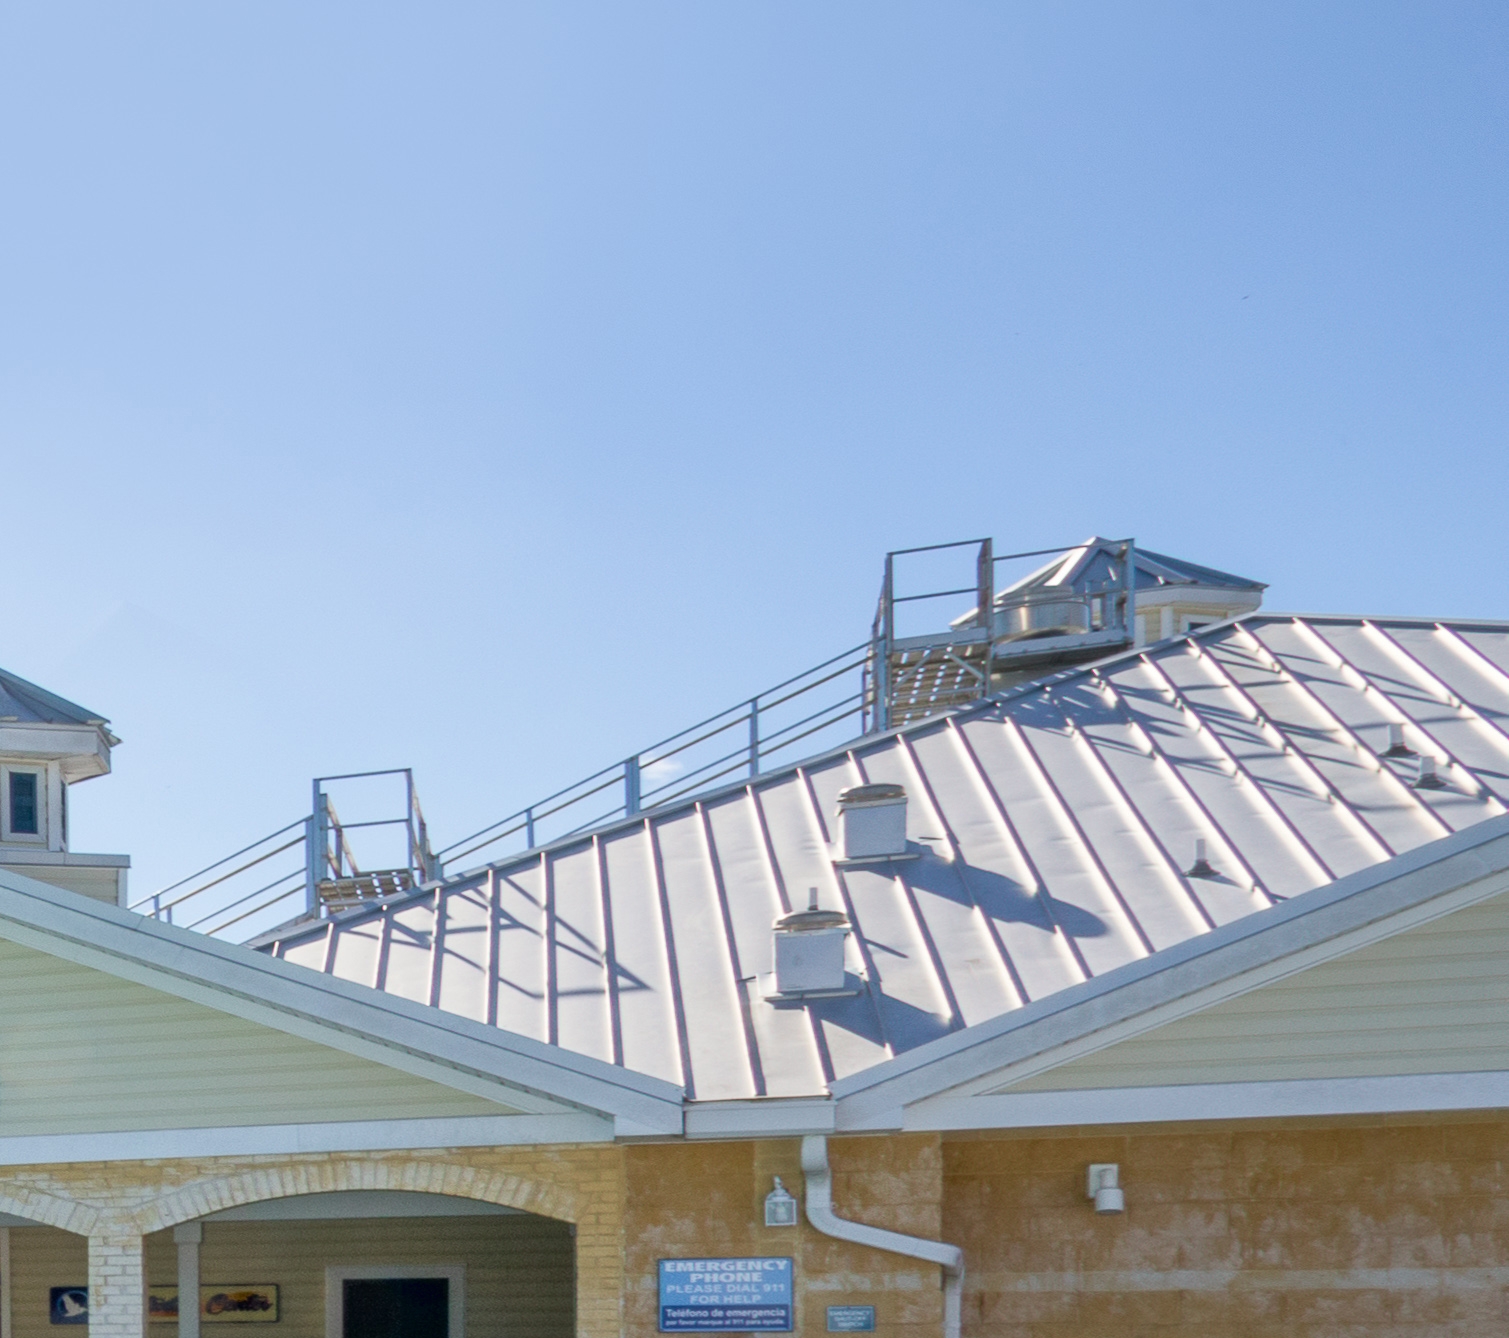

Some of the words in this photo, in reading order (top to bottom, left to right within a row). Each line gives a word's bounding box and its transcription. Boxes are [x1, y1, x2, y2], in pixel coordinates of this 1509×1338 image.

[663, 1260, 789, 1272] EMERGENCY
[689, 1272, 763, 1283] PHONE
[666, 1284, 723, 1293] PLEASE
[726, 1284, 760, 1293] DIAL
[762, 1283, 785, 1293] 911
[689, 1295, 720, 1304] FOR
[723, 1295, 762, 1304] HELP
[665, 1308, 710, 1318] Teléfono
[711, 1308, 724, 1318] de
[726, 1308, 787, 1319] emergencia
